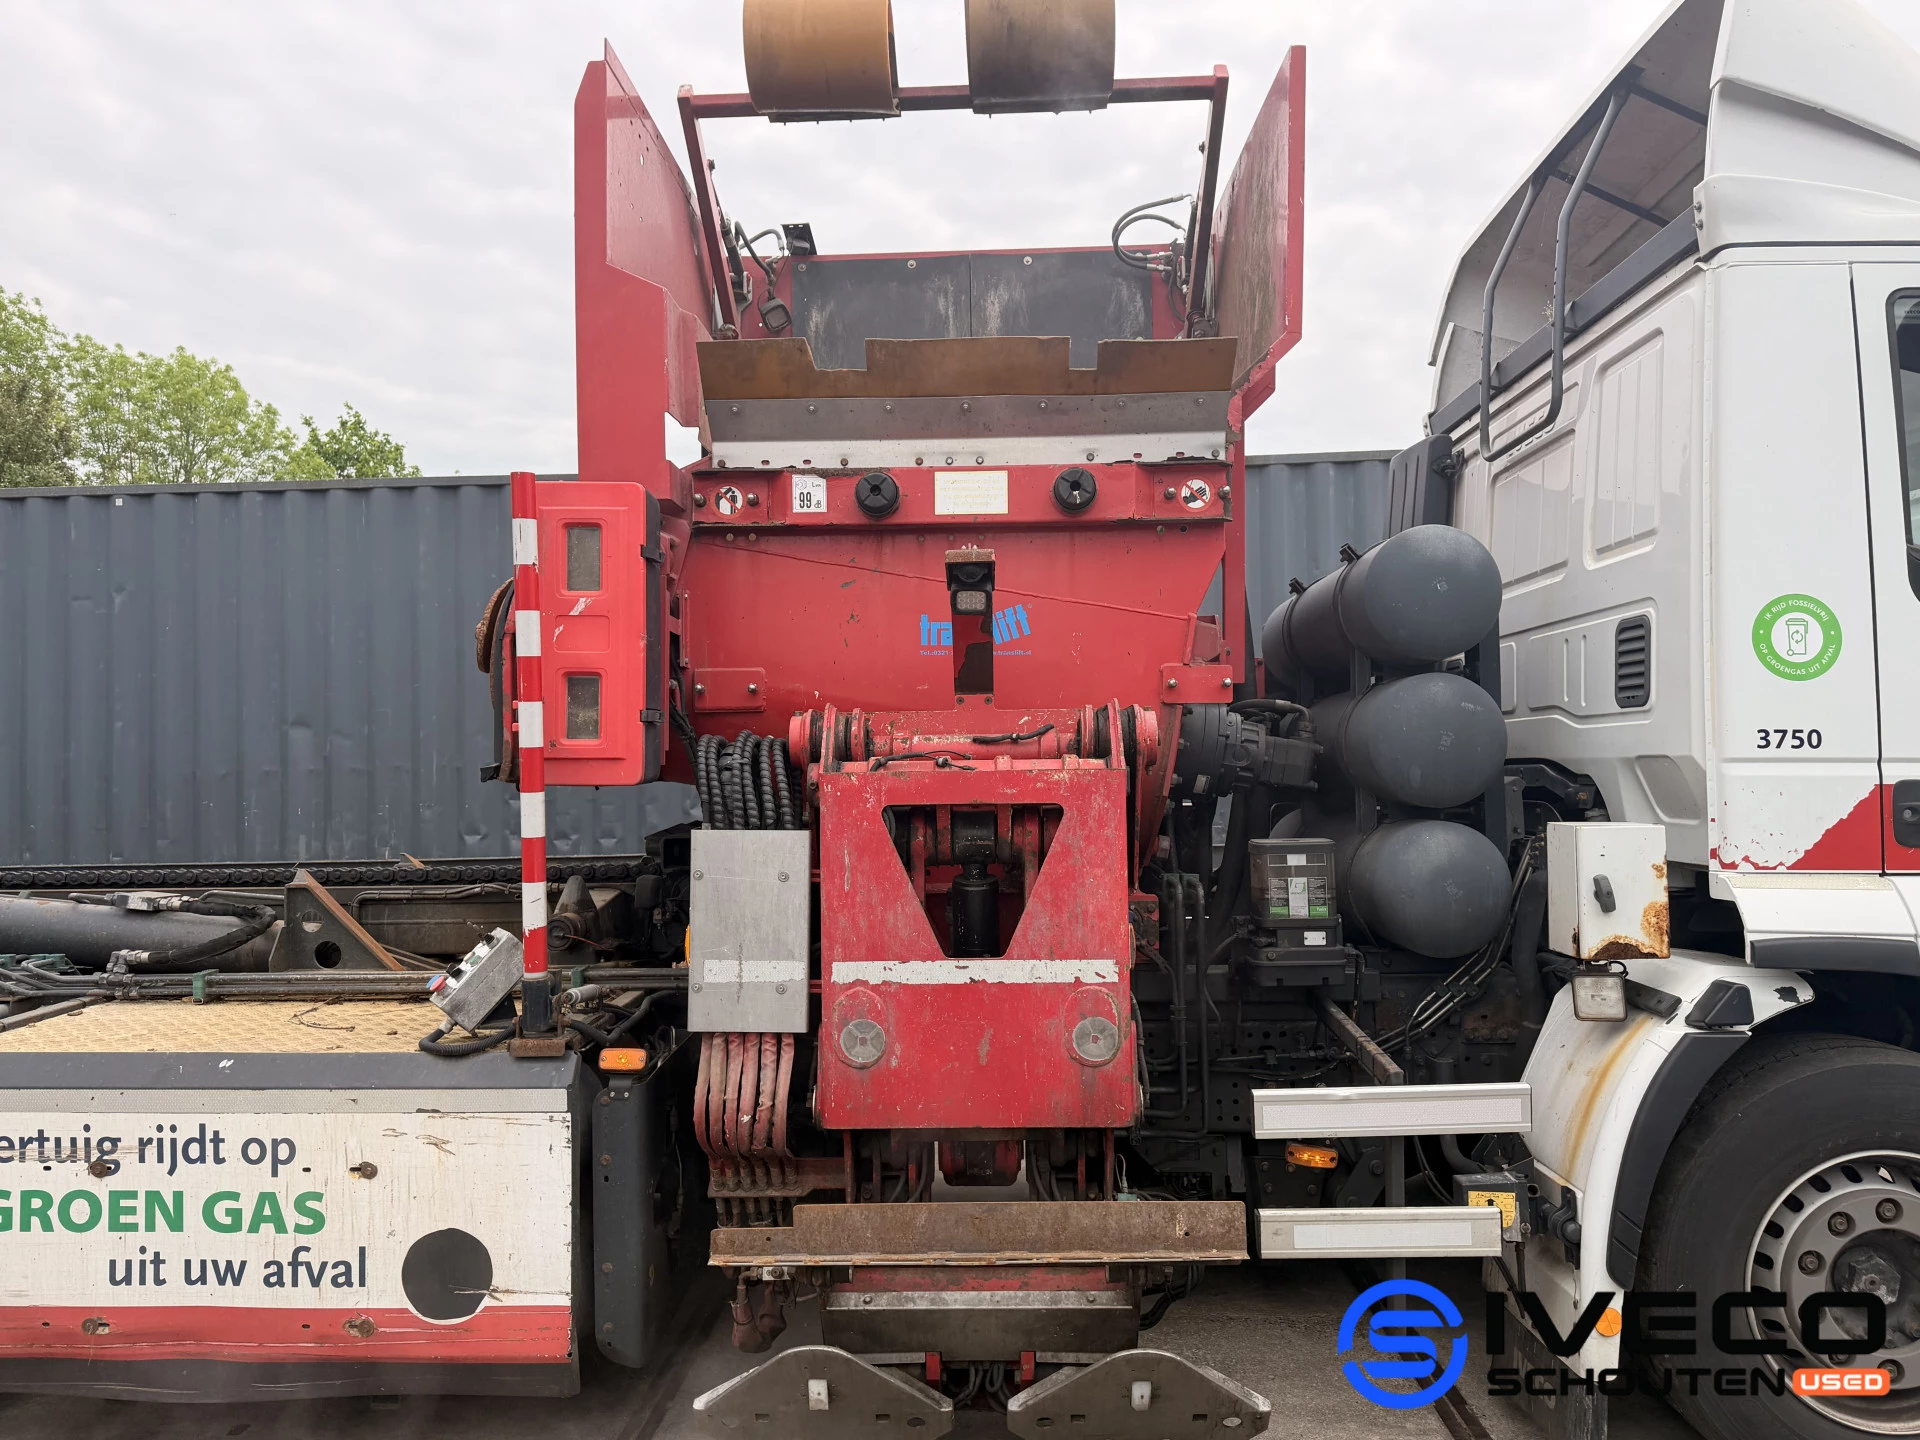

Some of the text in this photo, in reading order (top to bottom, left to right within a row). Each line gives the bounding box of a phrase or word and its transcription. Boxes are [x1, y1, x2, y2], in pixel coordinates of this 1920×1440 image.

[799, 491, 812, 509] 99
[1763, 599, 1829, 621] IK RIJD FOSSIELVRIJ
[1759, 643, 1836, 675] OP GROENGAS UIT AFVAL
[1756, 728, 1823, 750] 3750
[138, 1123, 226, 1177] rijdt
[240, 1136, 297, 1177] op
[201, 1190, 326, 1234] GAS
[108, 1245, 366, 1288] uit uw afval
